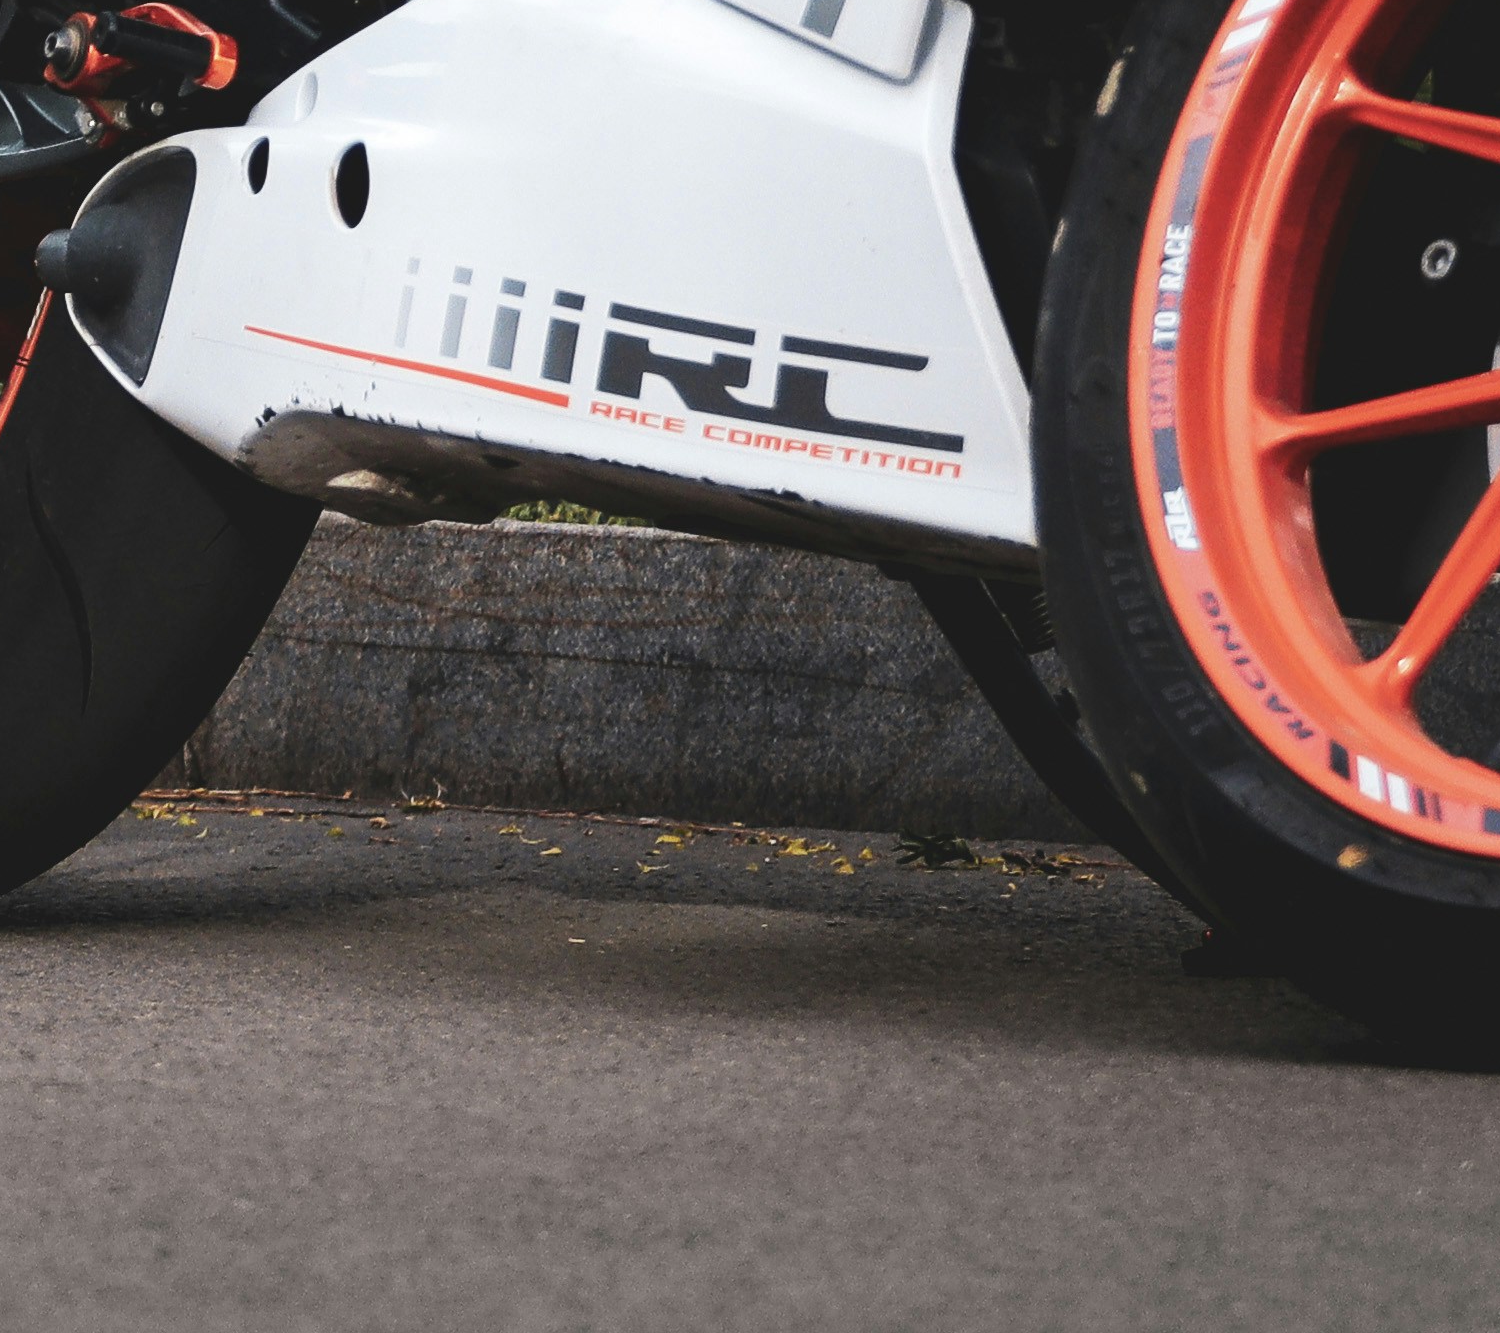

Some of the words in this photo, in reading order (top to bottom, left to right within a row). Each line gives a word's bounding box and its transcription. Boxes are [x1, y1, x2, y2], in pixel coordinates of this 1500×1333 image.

[1158, 223, 1193, 292] RACE
[1152, 309, 1179, 344] TO
[588, 400, 687, 434] RACE
[701, 422, 963, 480] COMPETITION
